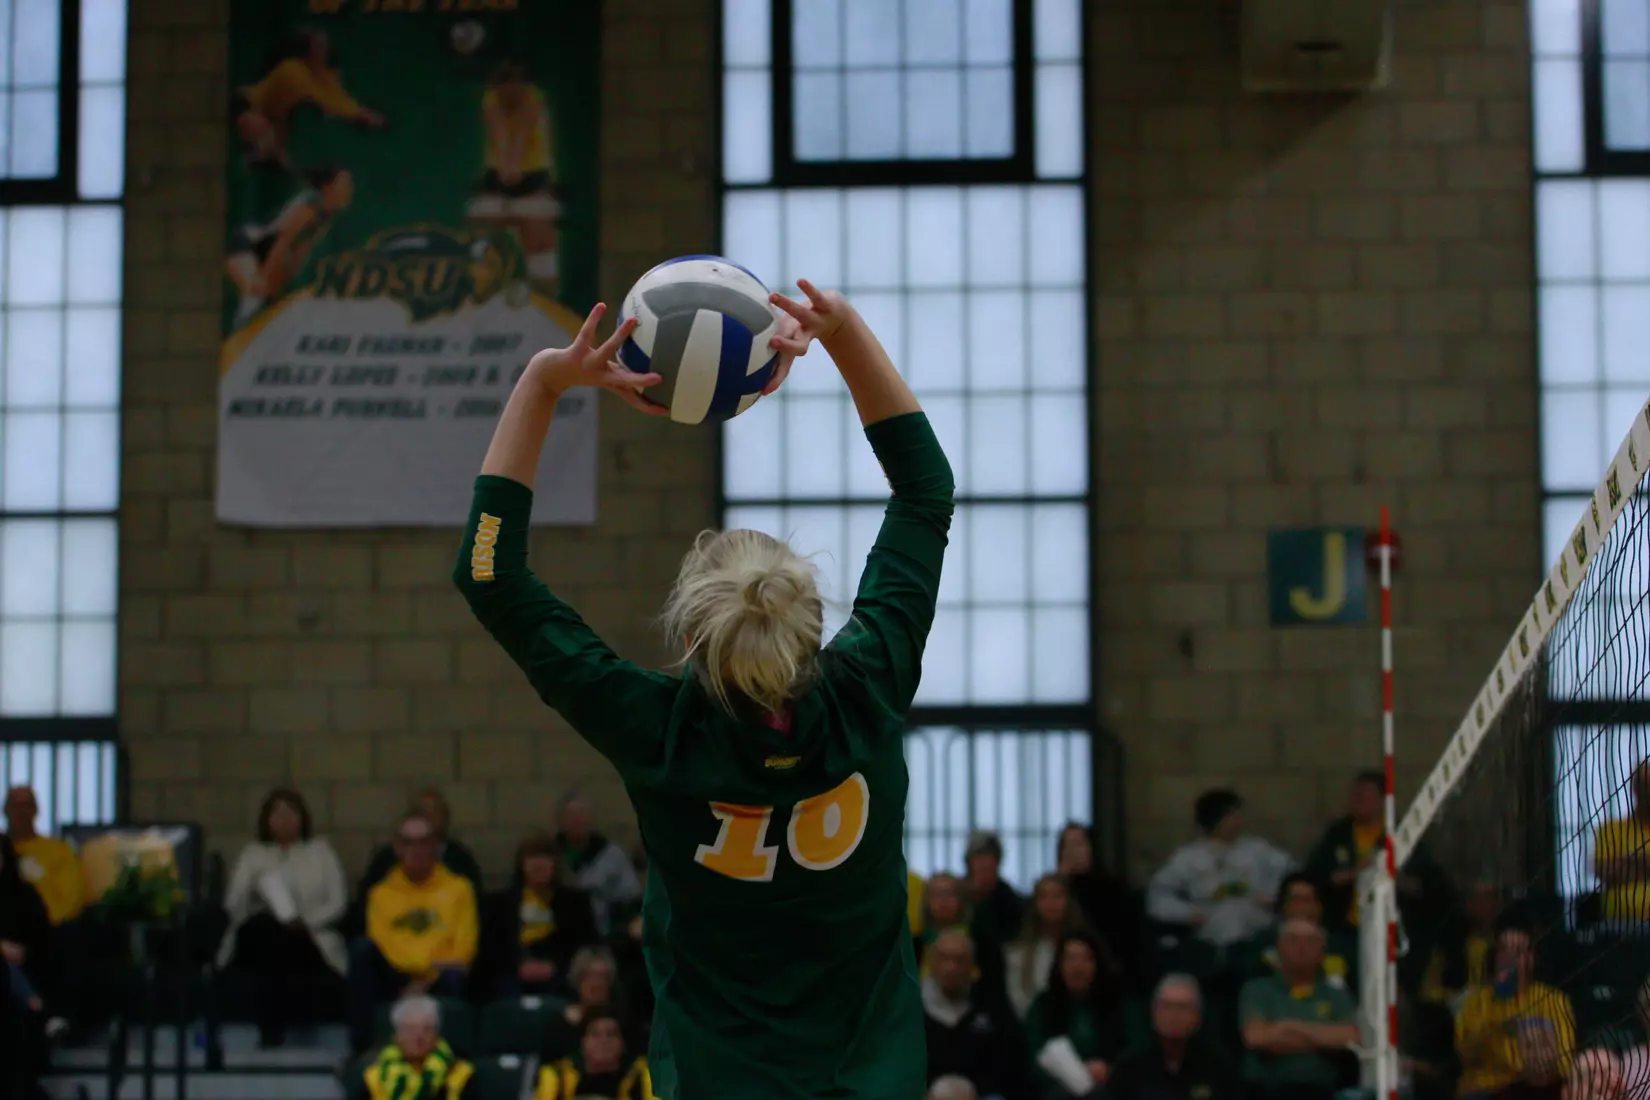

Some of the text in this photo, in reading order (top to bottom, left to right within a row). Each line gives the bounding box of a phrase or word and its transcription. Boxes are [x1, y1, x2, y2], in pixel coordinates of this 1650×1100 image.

[315, 256, 464, 299] NDSU
[471, 512, 502, 581] BISON
[1289, 530, 1346, 620] J
[694, 771, 870, 883] 10
